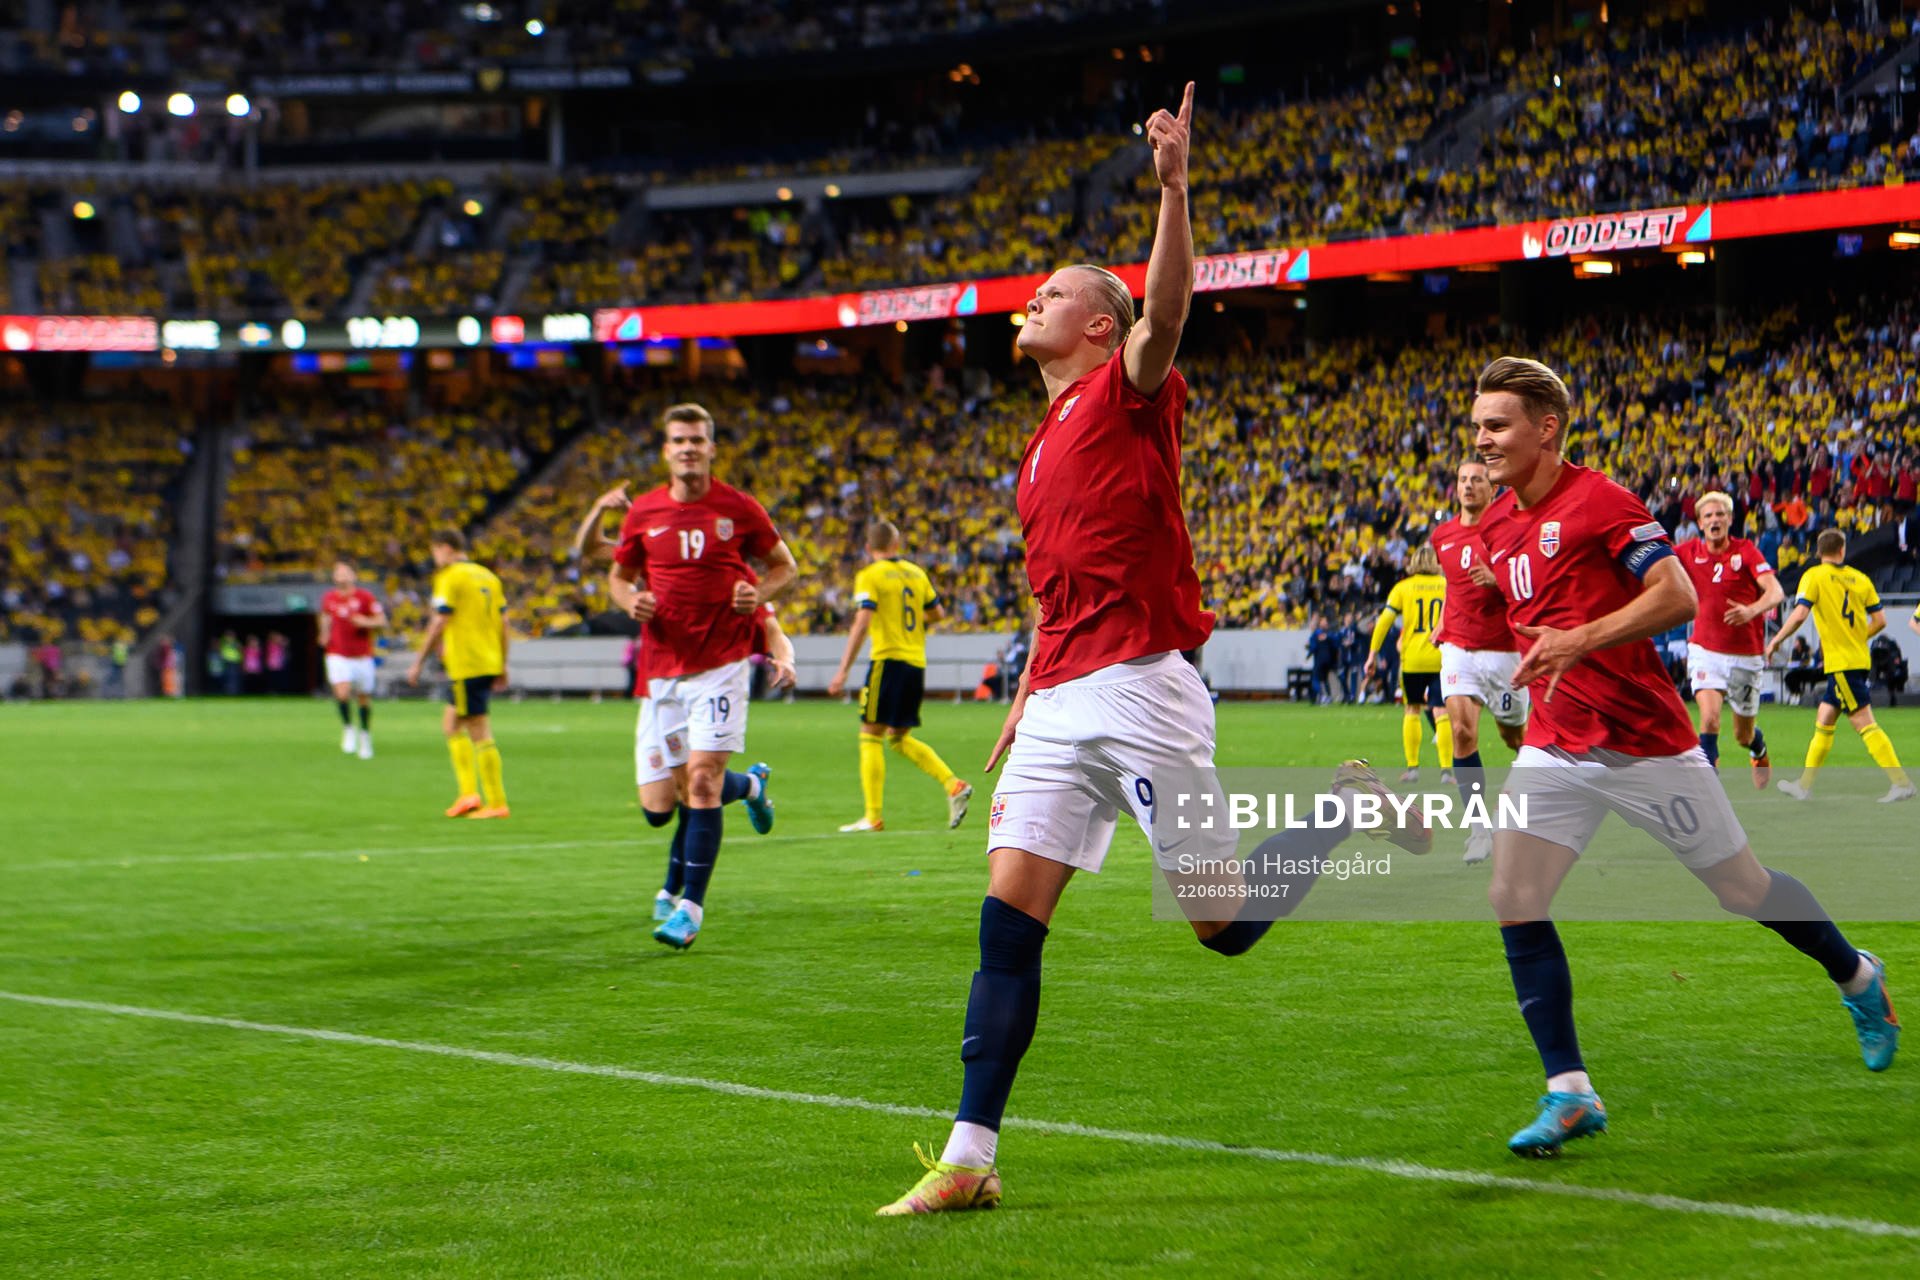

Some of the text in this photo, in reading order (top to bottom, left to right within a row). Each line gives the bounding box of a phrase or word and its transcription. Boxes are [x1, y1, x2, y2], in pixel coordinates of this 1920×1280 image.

[1546, 206, 1687, 256] ODDSET
[1193, 249, 1289, 292] DDSET
[678, 528, 705, 560] 19
[1461, 545, 1472, 569] 8
[1508, 553, 1534, 601] 10
[1712, 562, 1724, 583] 2
[903, 587, 916, 632] 6
[1414, 597, 1443, 633] 10
[1841, 589, 1855, 628] 4
[709, 696, 730, 723] 19
[1502, 692, 1512, 712] 8
[1743, 684, 1753, 703] 2
[1135, 777, 1158, 824] 9
[1649, 795, 1699, 839] 10
